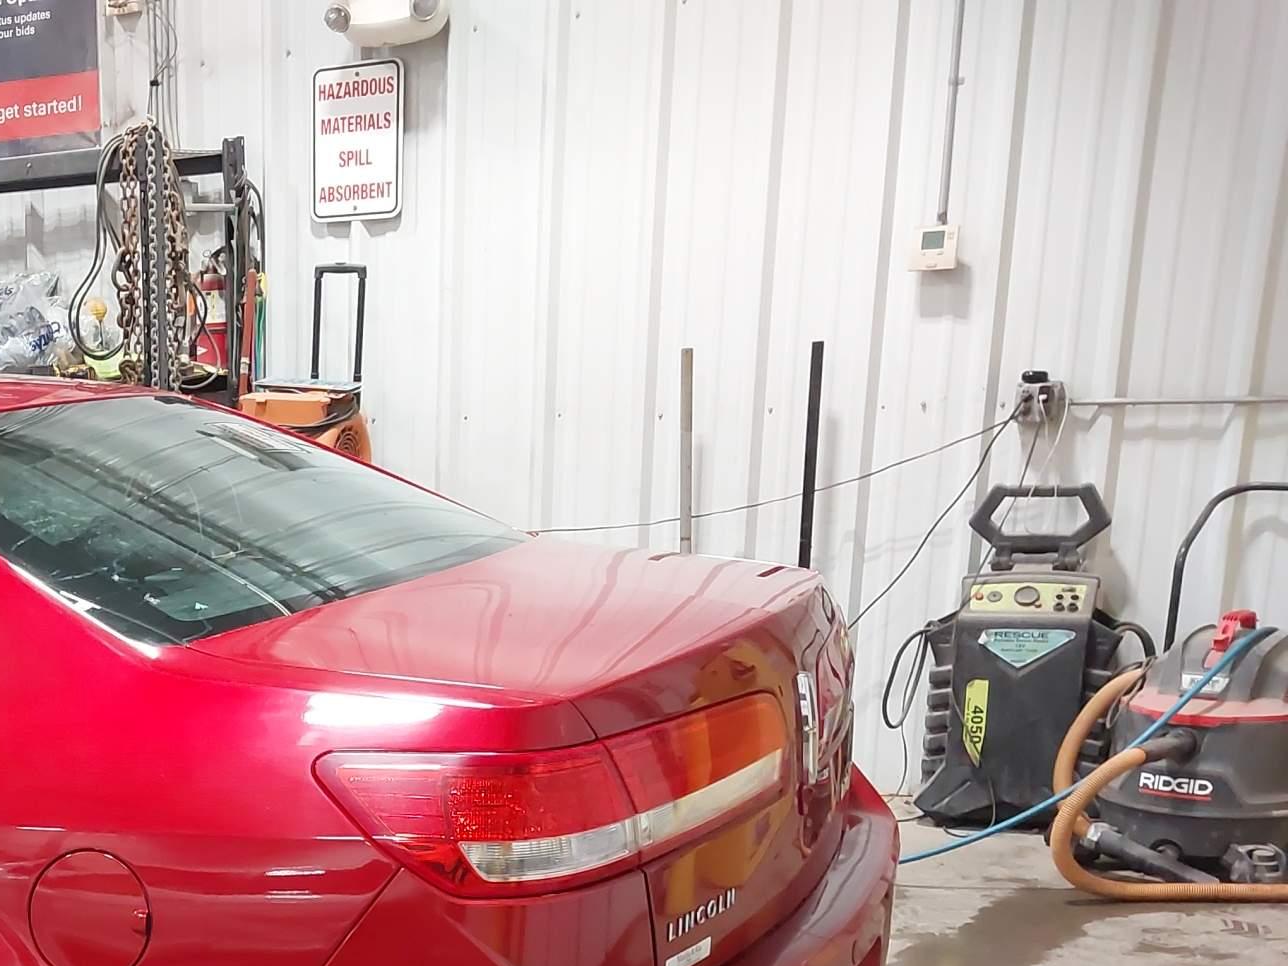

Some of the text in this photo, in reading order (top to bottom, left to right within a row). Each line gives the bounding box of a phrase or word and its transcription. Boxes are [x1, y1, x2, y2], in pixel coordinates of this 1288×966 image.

[14, 10, 51, 25] updates
[15, 25, 35, 37] bids
[318, 76, 395, 102] HAZARDOUS
[23, 95, 82, 117] started!
[320, 111, 392, 136] MATERIALS
[338, 149, 373, 168] SPILL
[319, 181, 393, 204] ABSORBENT
[993, 630, 1049, 639] RESCUE
[969, 705, 985, 745] 4050
[1139, 772, 1214, 796] RIDGID
[668, 887, 736, 943] LINCOLN
